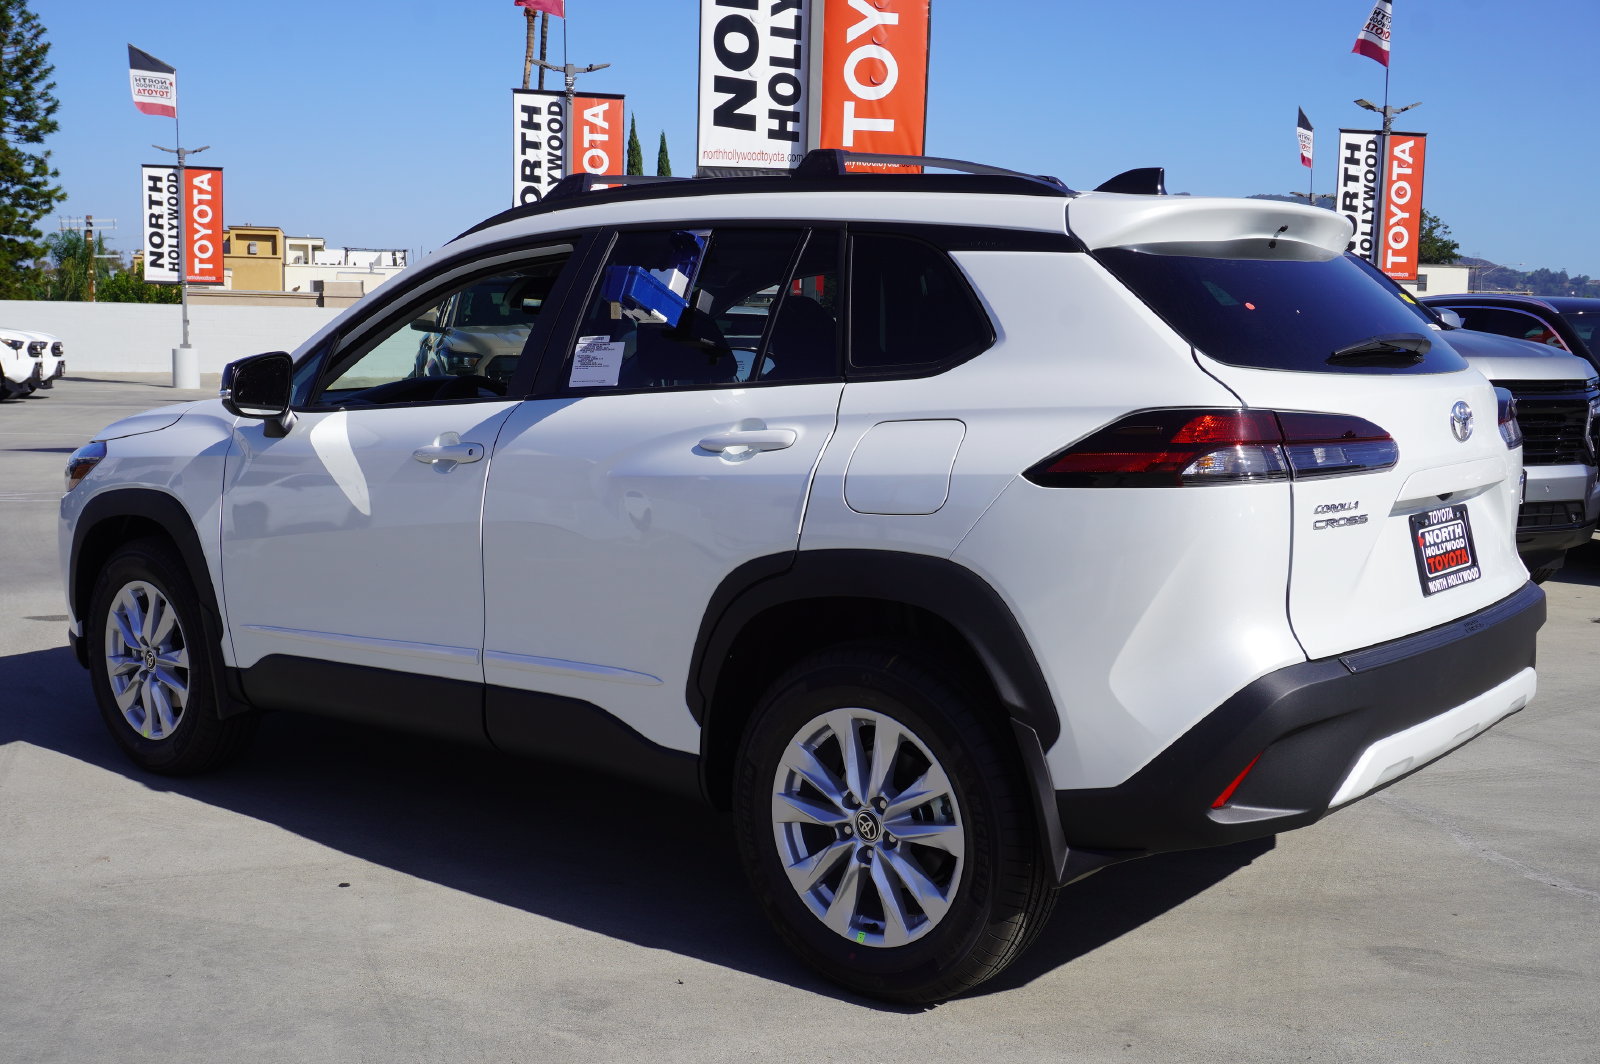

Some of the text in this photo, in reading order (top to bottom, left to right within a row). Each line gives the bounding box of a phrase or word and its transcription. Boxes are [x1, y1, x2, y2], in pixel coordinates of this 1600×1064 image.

[767, 0, 803, 143] HOLLY
[842, 0, 900, 147] TOY
[520, 104, 542, 206] ORTH
[547, 101, 564, 187] YWOOD
[583, 102, 609, 182] OTA
[148, 175, 165, 269] NORTH
[167, 173, 180, 272] HOLLYWOOD
[193, 173, 214, 274] TOYOTA
[1387, 140, 1415, 269] TOYOTA
[1313, 501, 1359, 514] COROLLA
[1313, 513, 1369, 530] CROSS
[1424, 523, 1463, 546] NORTH
[1425, 538, 1466, 557] HOLLYWOOD
[1428, 507, 1454, 524] TOYOTA
[1427, 548, 1469, 573] TOYOTA
[1428, 567, 1480, 593] NORTH HOLLYWOOD
